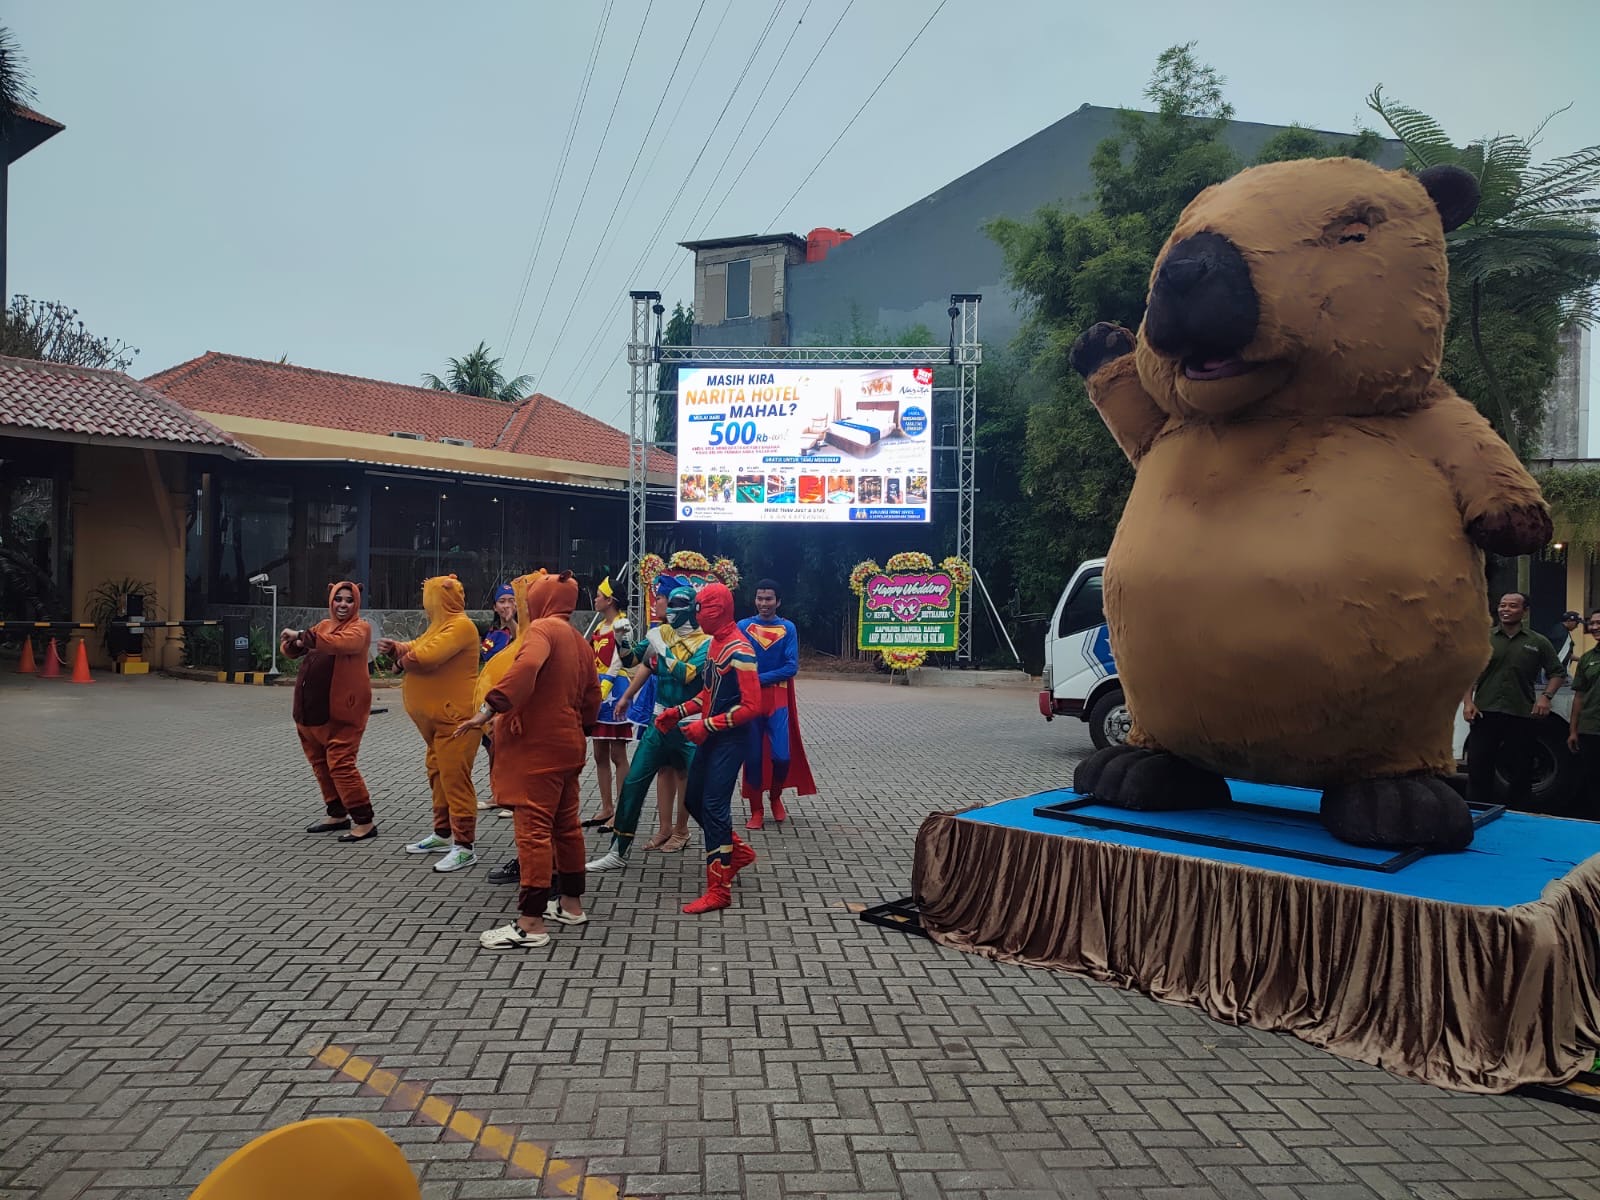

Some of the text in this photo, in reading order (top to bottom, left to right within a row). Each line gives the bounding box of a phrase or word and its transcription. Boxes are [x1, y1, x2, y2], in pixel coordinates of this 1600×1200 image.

[707, 373, 775, 387] MASIH KIRA
[685, 385, 800, 406] NARITA HOTEL
[729, 403, 798, 419] MAHAL?
[708, 421, 757, 446] 500
[872, 581, 947, 597] Happy Wedding
